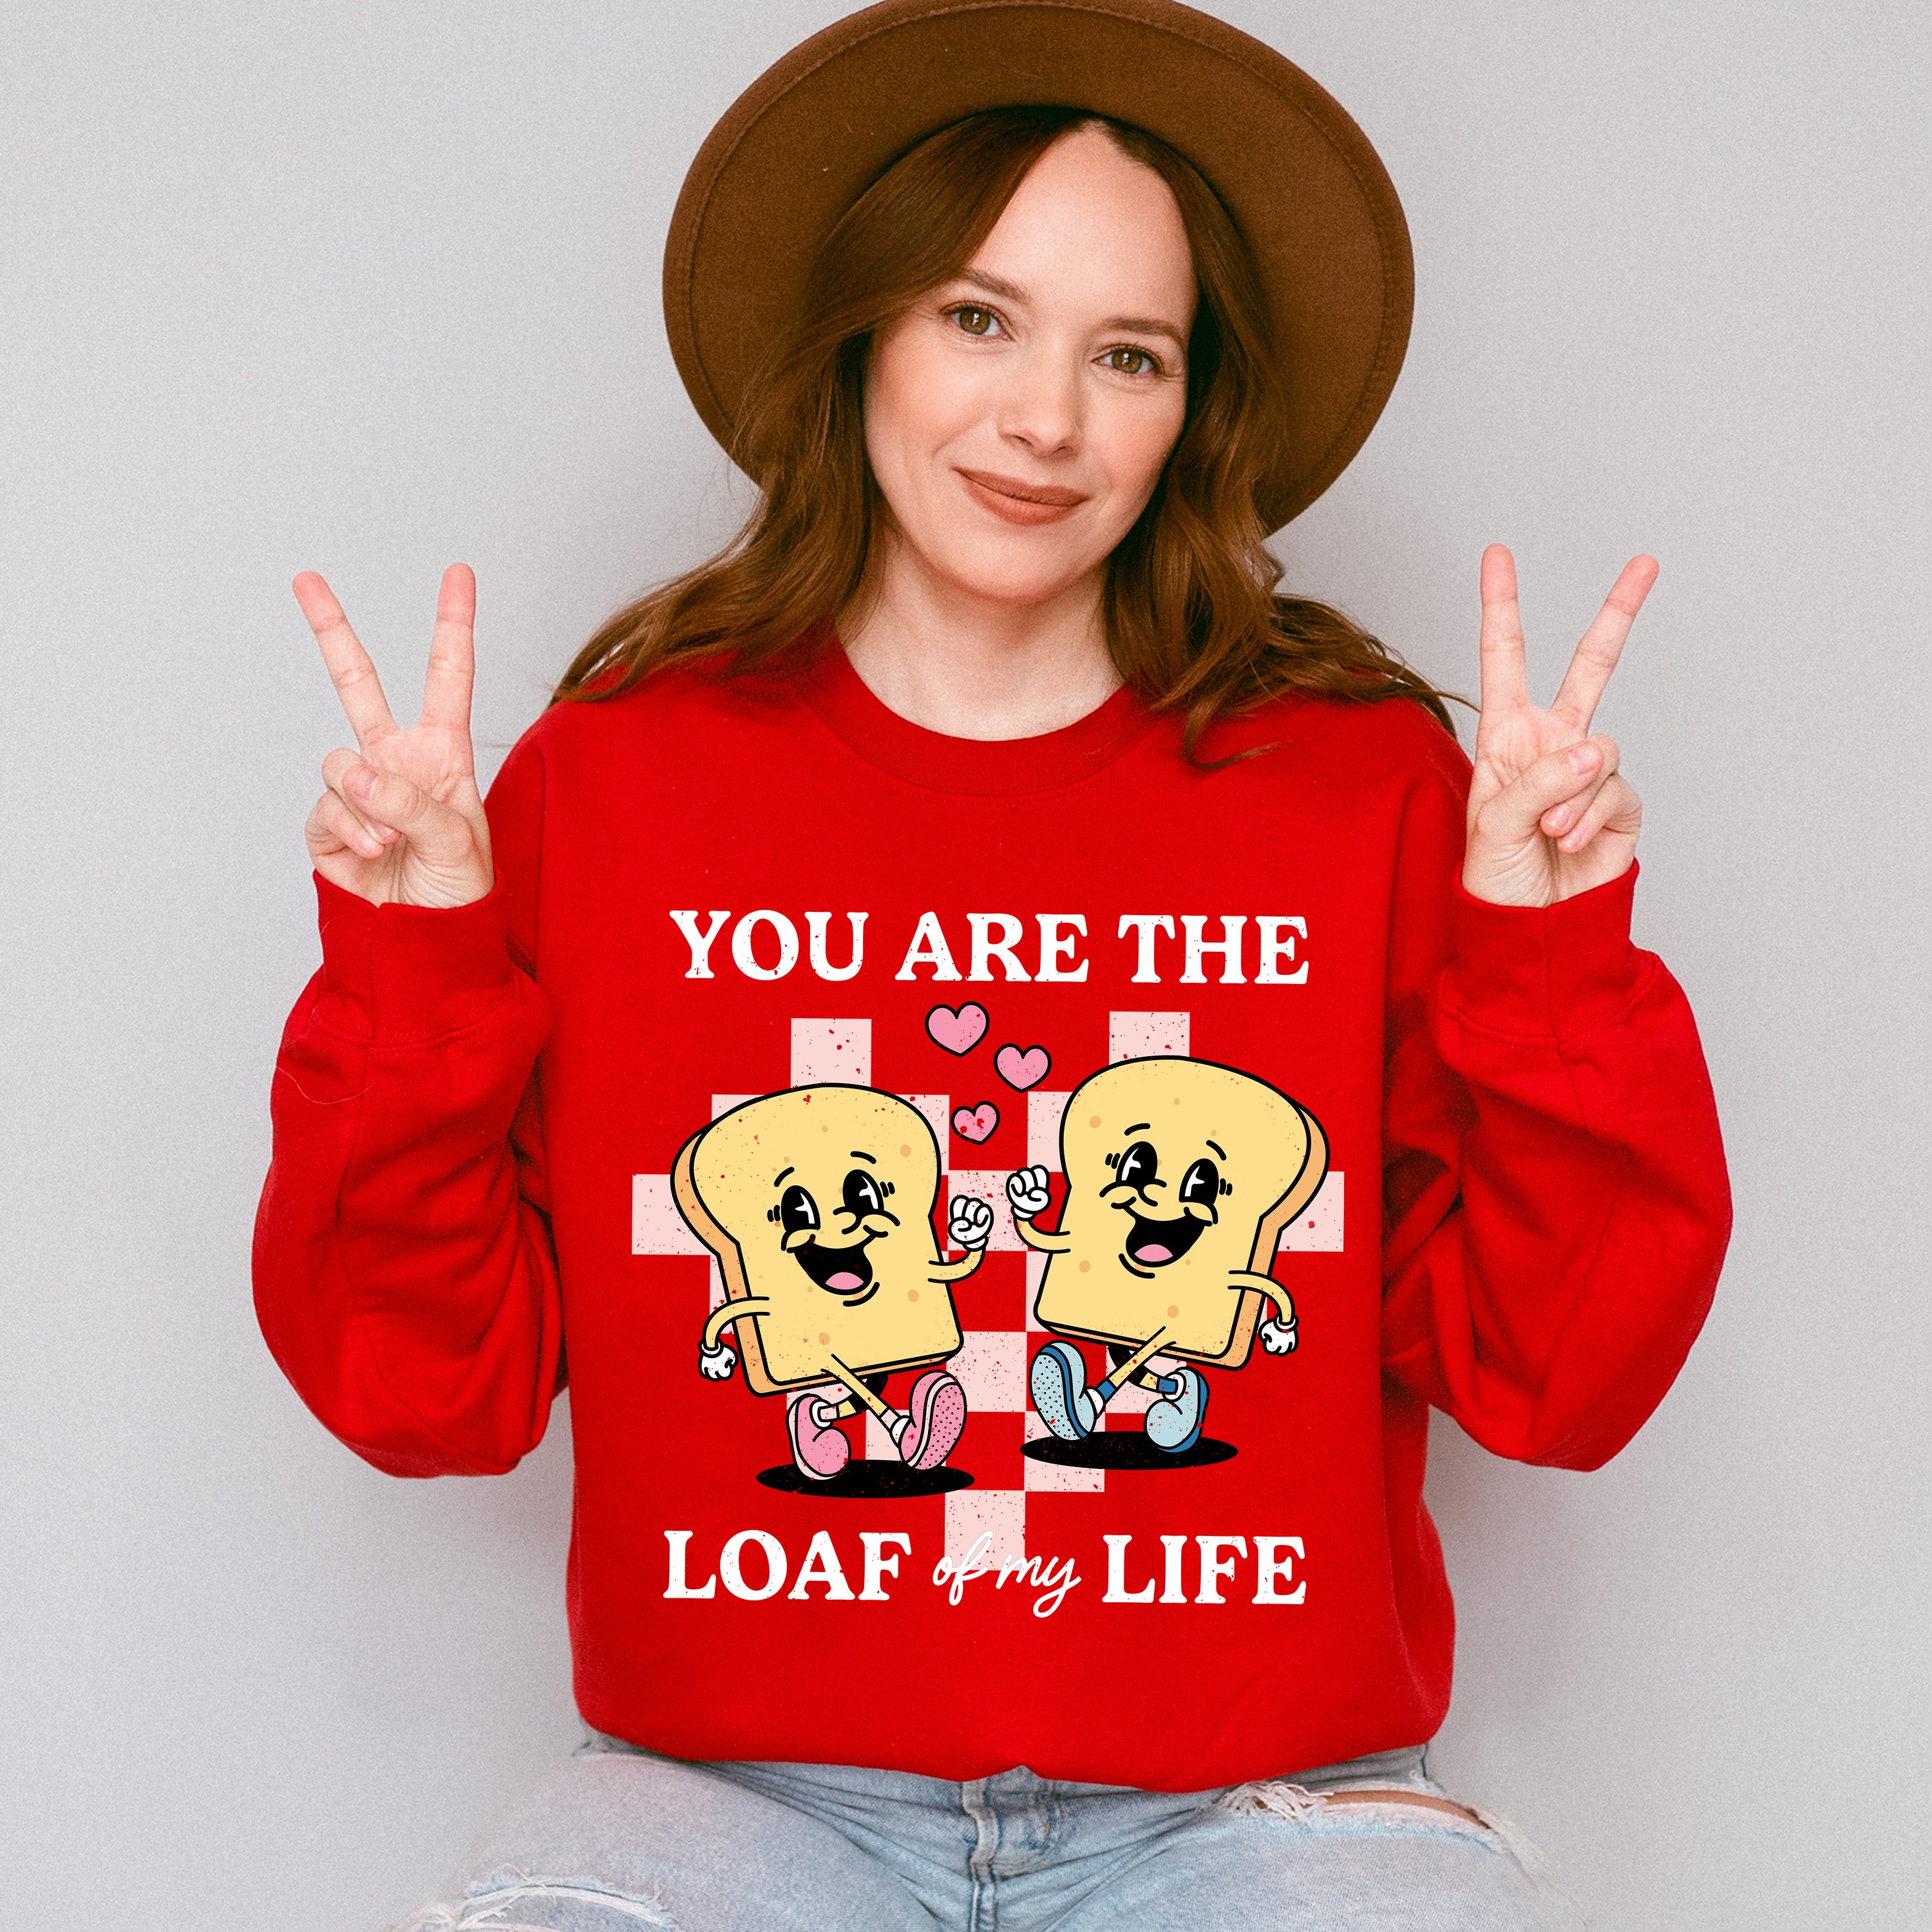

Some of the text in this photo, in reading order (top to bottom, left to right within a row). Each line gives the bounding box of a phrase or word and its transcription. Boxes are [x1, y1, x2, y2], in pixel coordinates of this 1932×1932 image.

[669, 909, 1309, 985] YOU ARE THE
[663, 1530, 1307, 1618] LOAF of my LIFE
